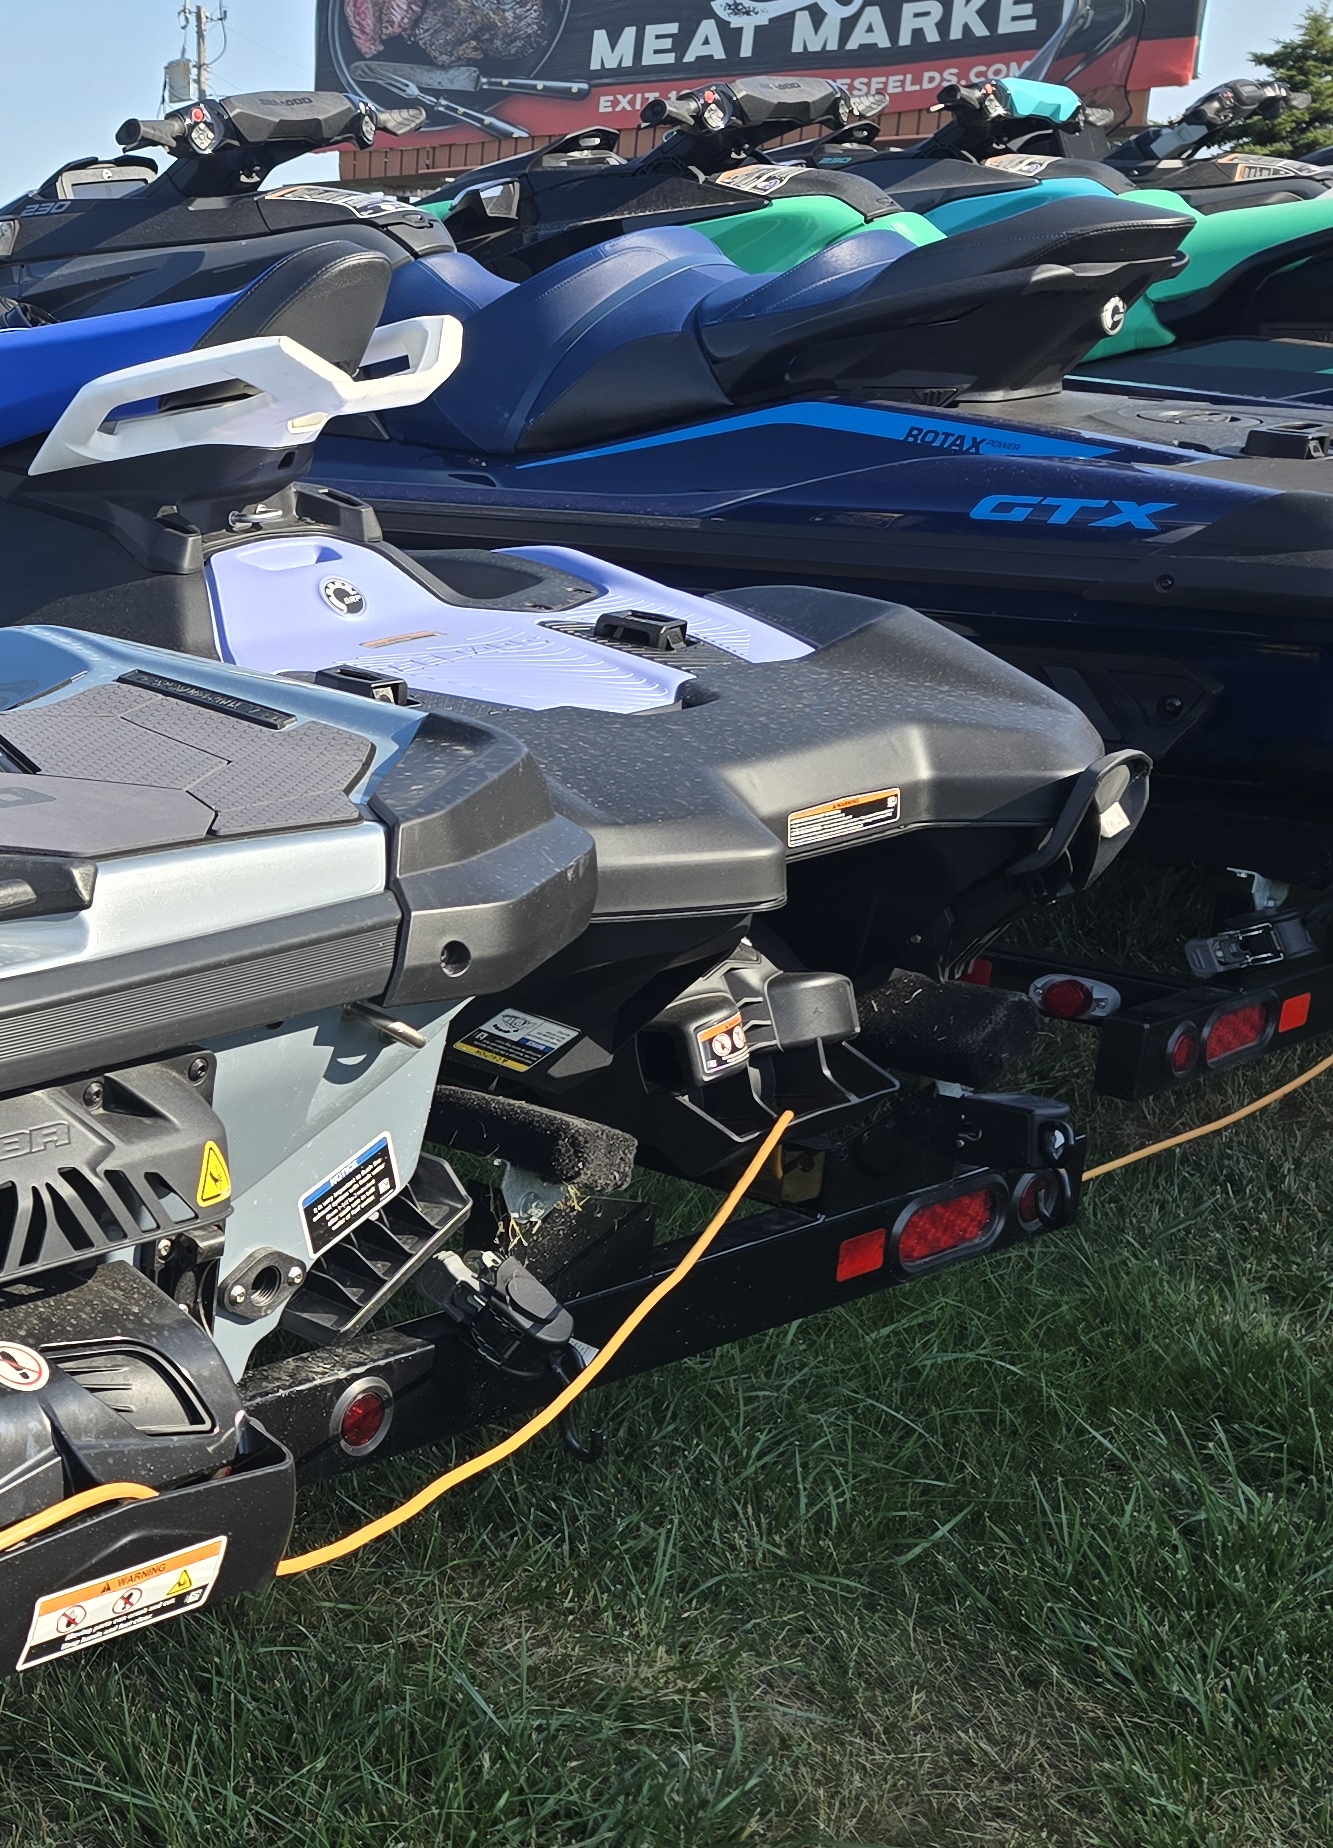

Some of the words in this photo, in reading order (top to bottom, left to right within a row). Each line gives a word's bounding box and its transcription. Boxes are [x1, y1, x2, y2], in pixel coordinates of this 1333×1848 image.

[589, 18, 770, 71] MEAT
[598, 91, 660, 113] EXIT
[20, 201, 72, 217] 230
[902, 426, 987, 454] ROTAX
[985, 438, 1021, 451] POWER
[969, 494, 1179, 531] GTX
[117, 1563, 166, 1588] WARNING
